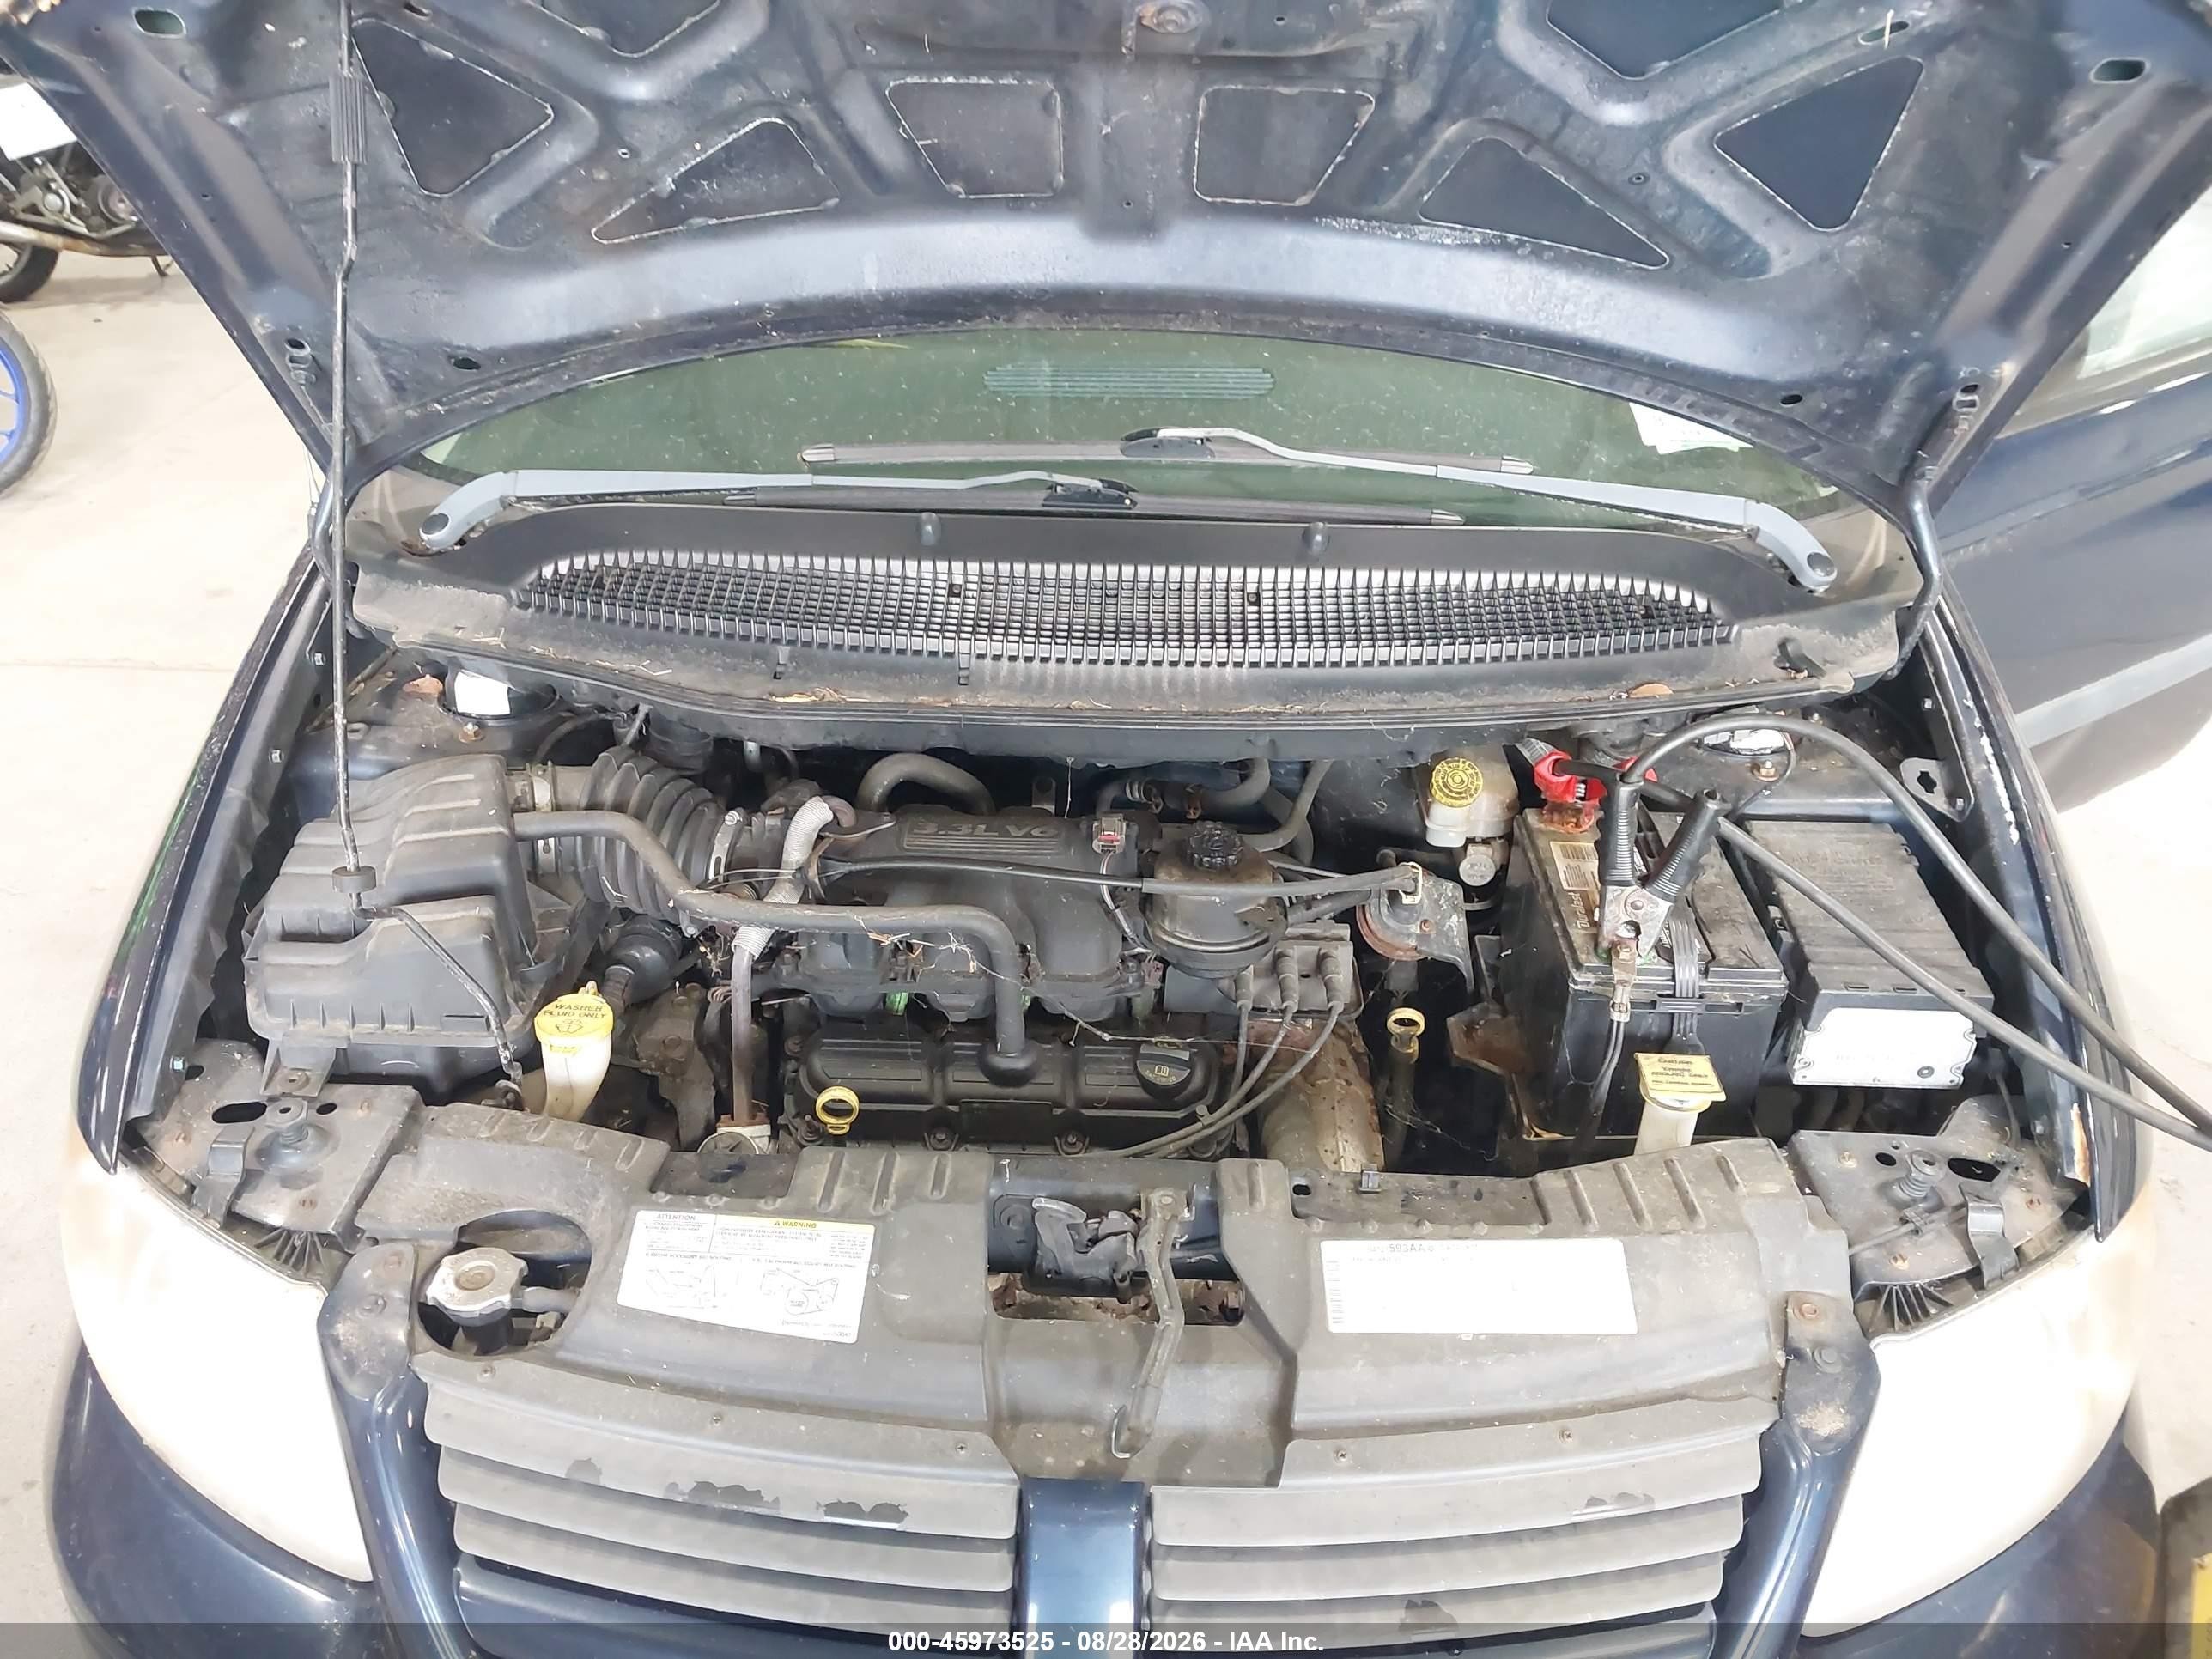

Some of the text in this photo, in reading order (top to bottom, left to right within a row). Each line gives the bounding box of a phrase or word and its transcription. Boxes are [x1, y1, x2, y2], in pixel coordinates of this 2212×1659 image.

[913, 822, 1060, 838] 3.3L V6
[1567, 891, 1591, 929] Duralast
[555, 1003, 603, 1012] WASHER
[543, 1009, 575, 1018] FLUID
[782, 1220, 817, 1230] WARNING
